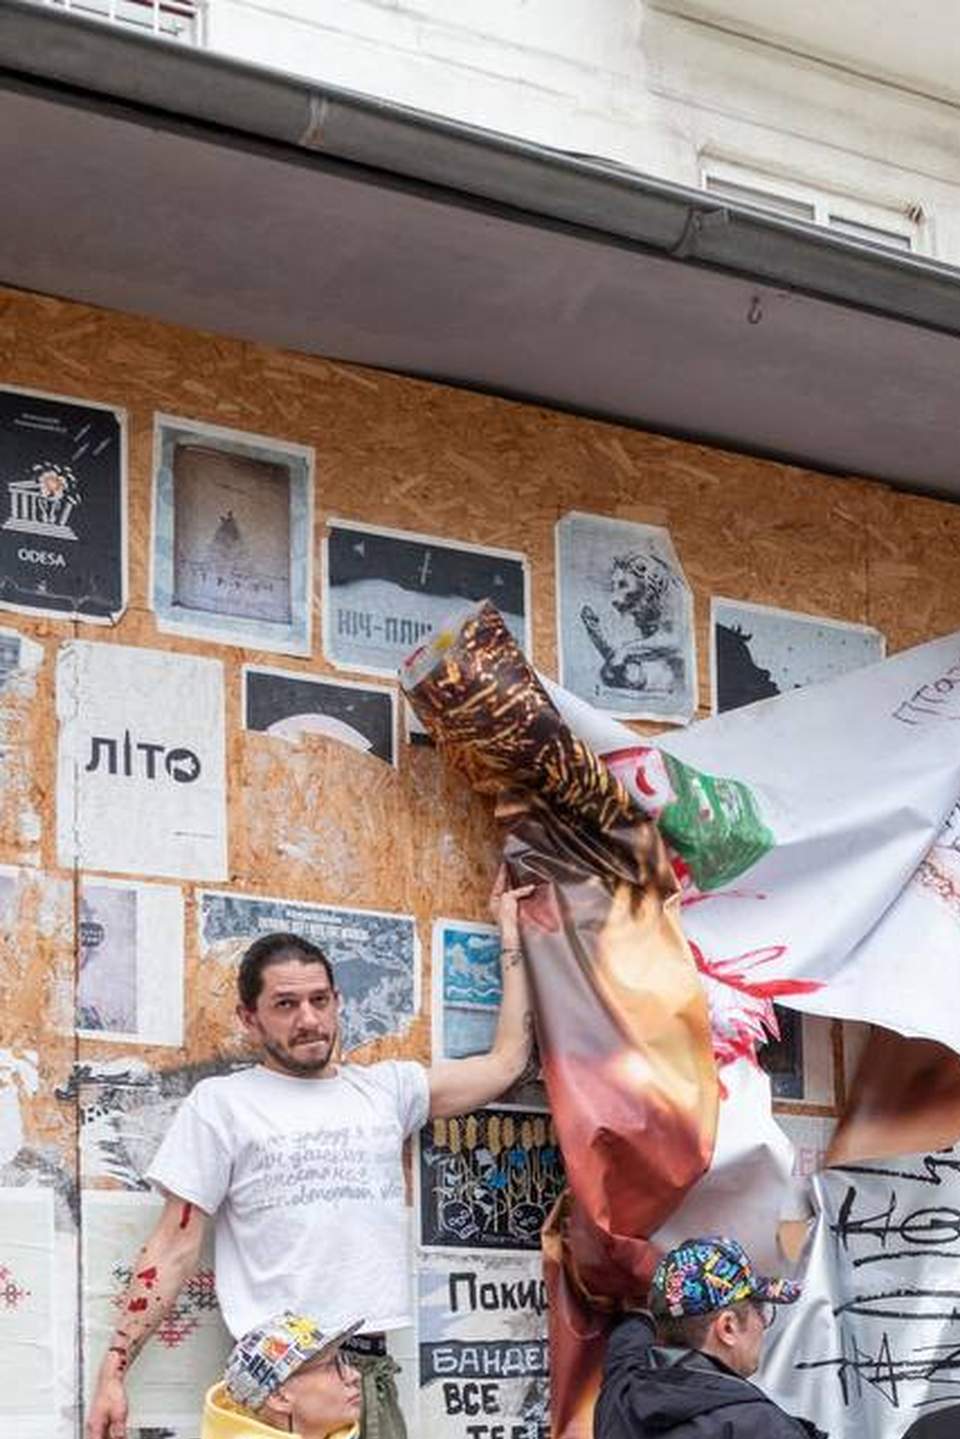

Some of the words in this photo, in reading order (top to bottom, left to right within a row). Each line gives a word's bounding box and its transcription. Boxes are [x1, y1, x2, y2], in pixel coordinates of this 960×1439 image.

[17, 548, 67, 568] ODESA
[432, 1347, 549, 1376] БАНДЕ
[443, 1382, 500, 1416] ВСЕ
